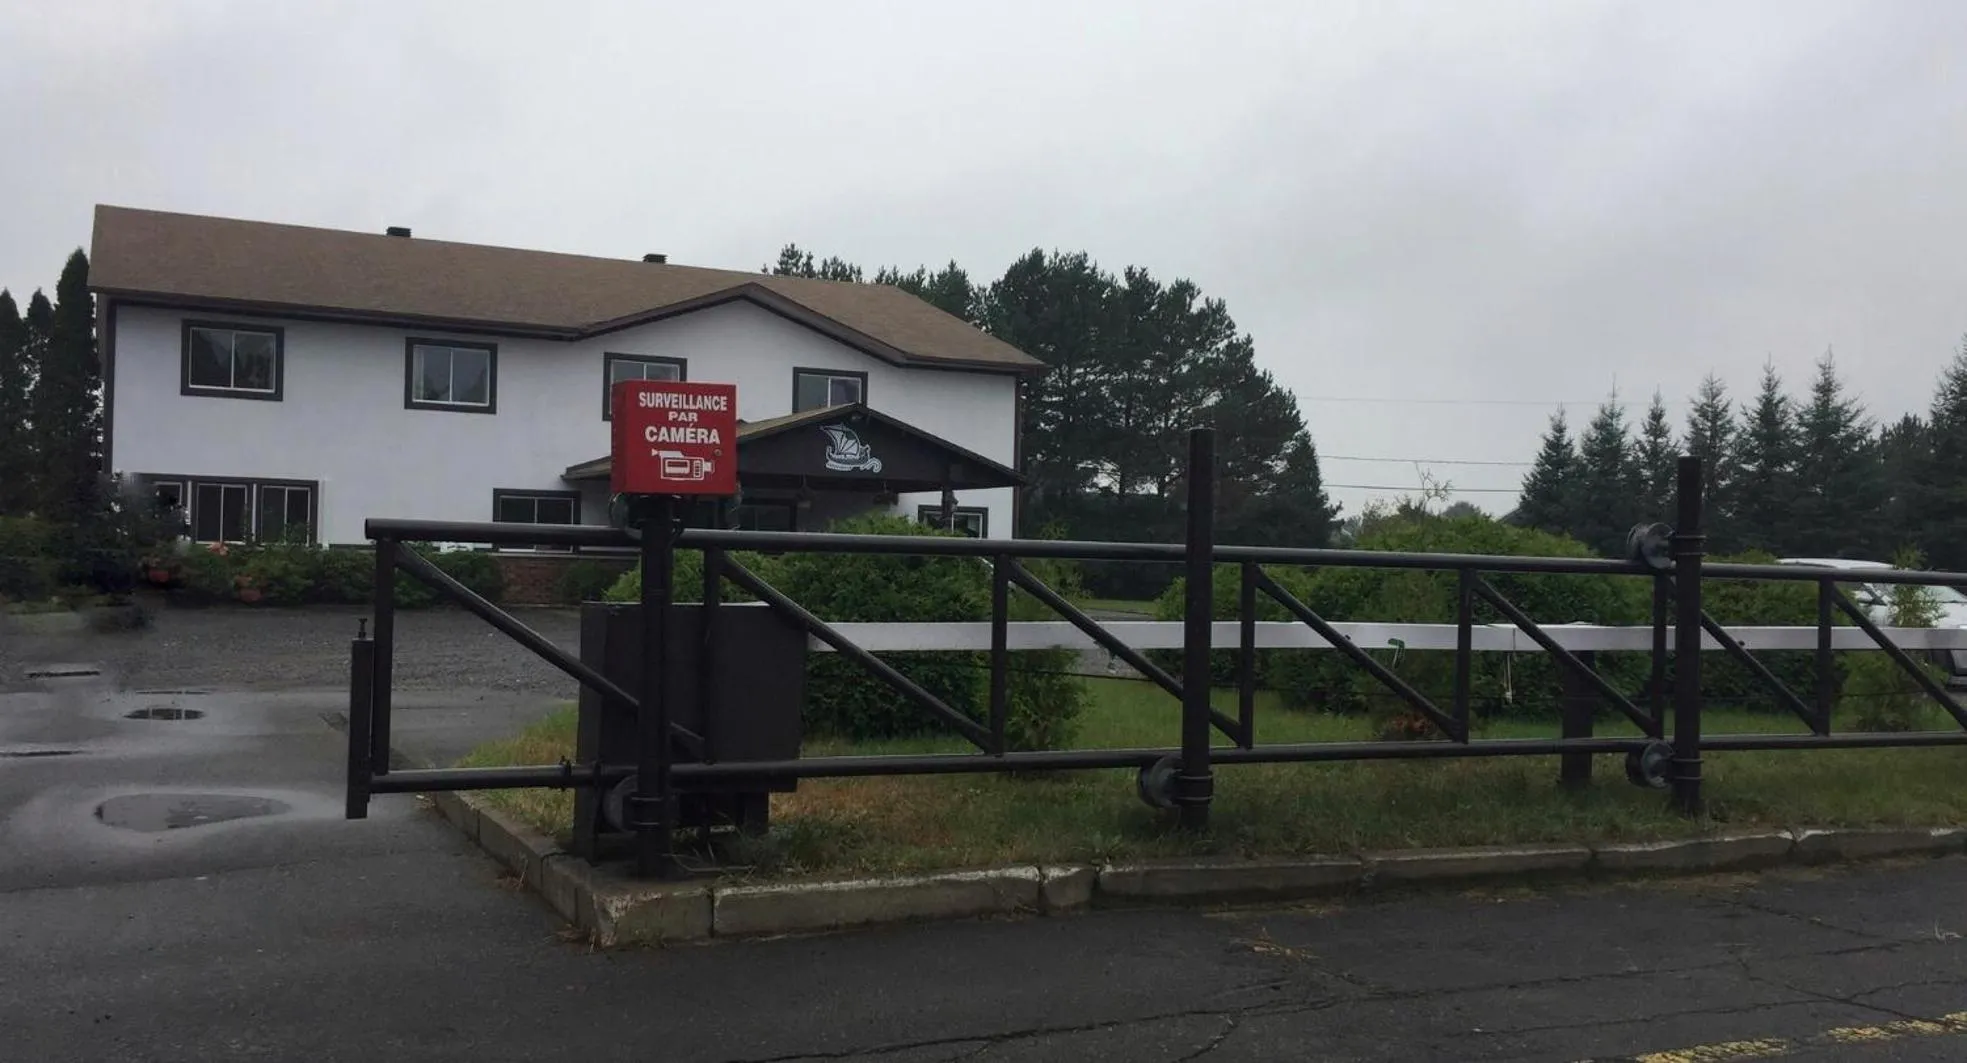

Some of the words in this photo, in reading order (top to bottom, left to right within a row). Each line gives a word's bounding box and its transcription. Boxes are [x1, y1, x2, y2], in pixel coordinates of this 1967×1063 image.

[639, 392, 728, 411] SURVEILLANCE
[668, 411, 698, 422] PAR
[645, 423, 721, 444] CAMÉRA
